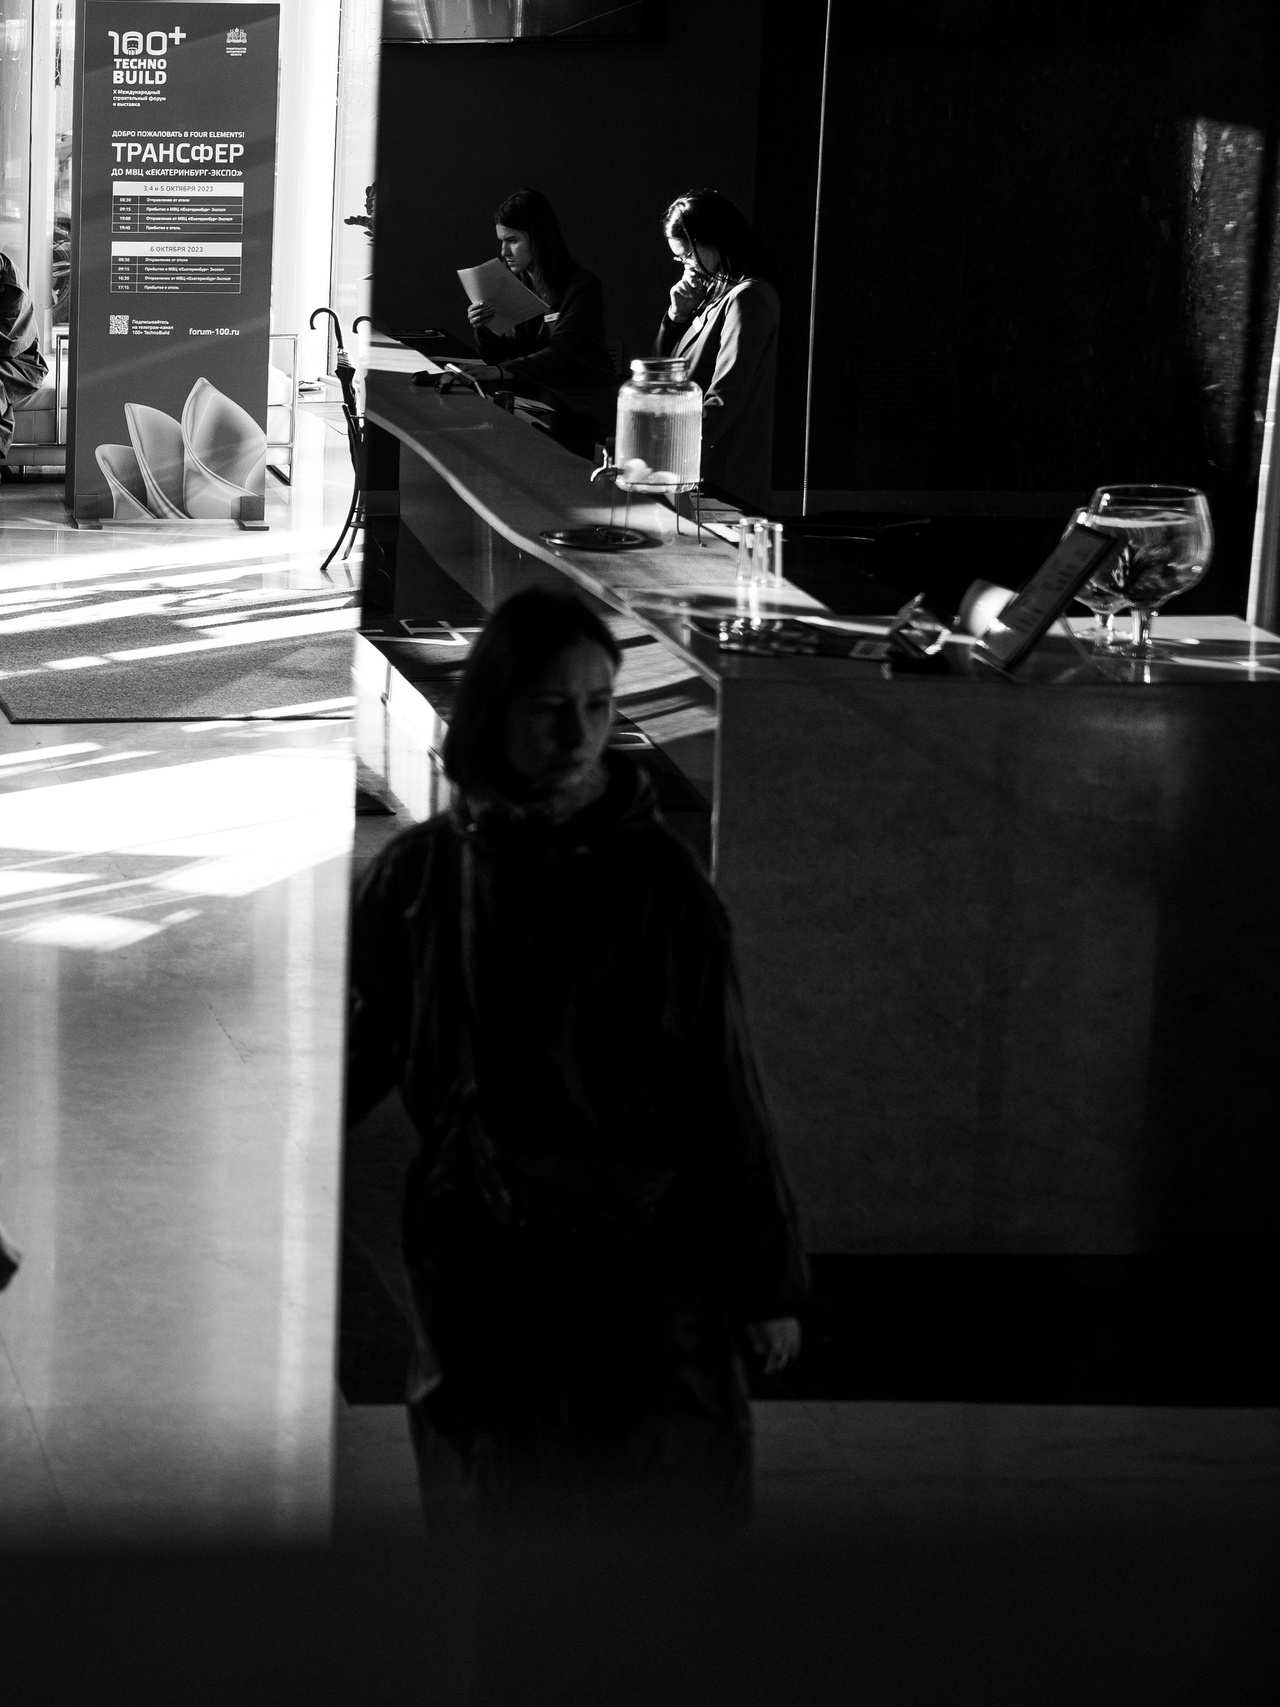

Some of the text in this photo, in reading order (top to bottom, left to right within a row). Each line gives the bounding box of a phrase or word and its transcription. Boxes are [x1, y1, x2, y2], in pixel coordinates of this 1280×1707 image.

[108, 26, 187, 56] 100+
[114, 58, 167, 69] TECHNO
[113, 70, 167, 85] BUILD
[111, 143, 245, 163] ТРАНСФЕР
[111, 168, 243, 177] ДО МВЦ «ЕКАТЕРИНБУРГ-ЭКСПО»
[188, 328, 240, 336] forum-100.ru
